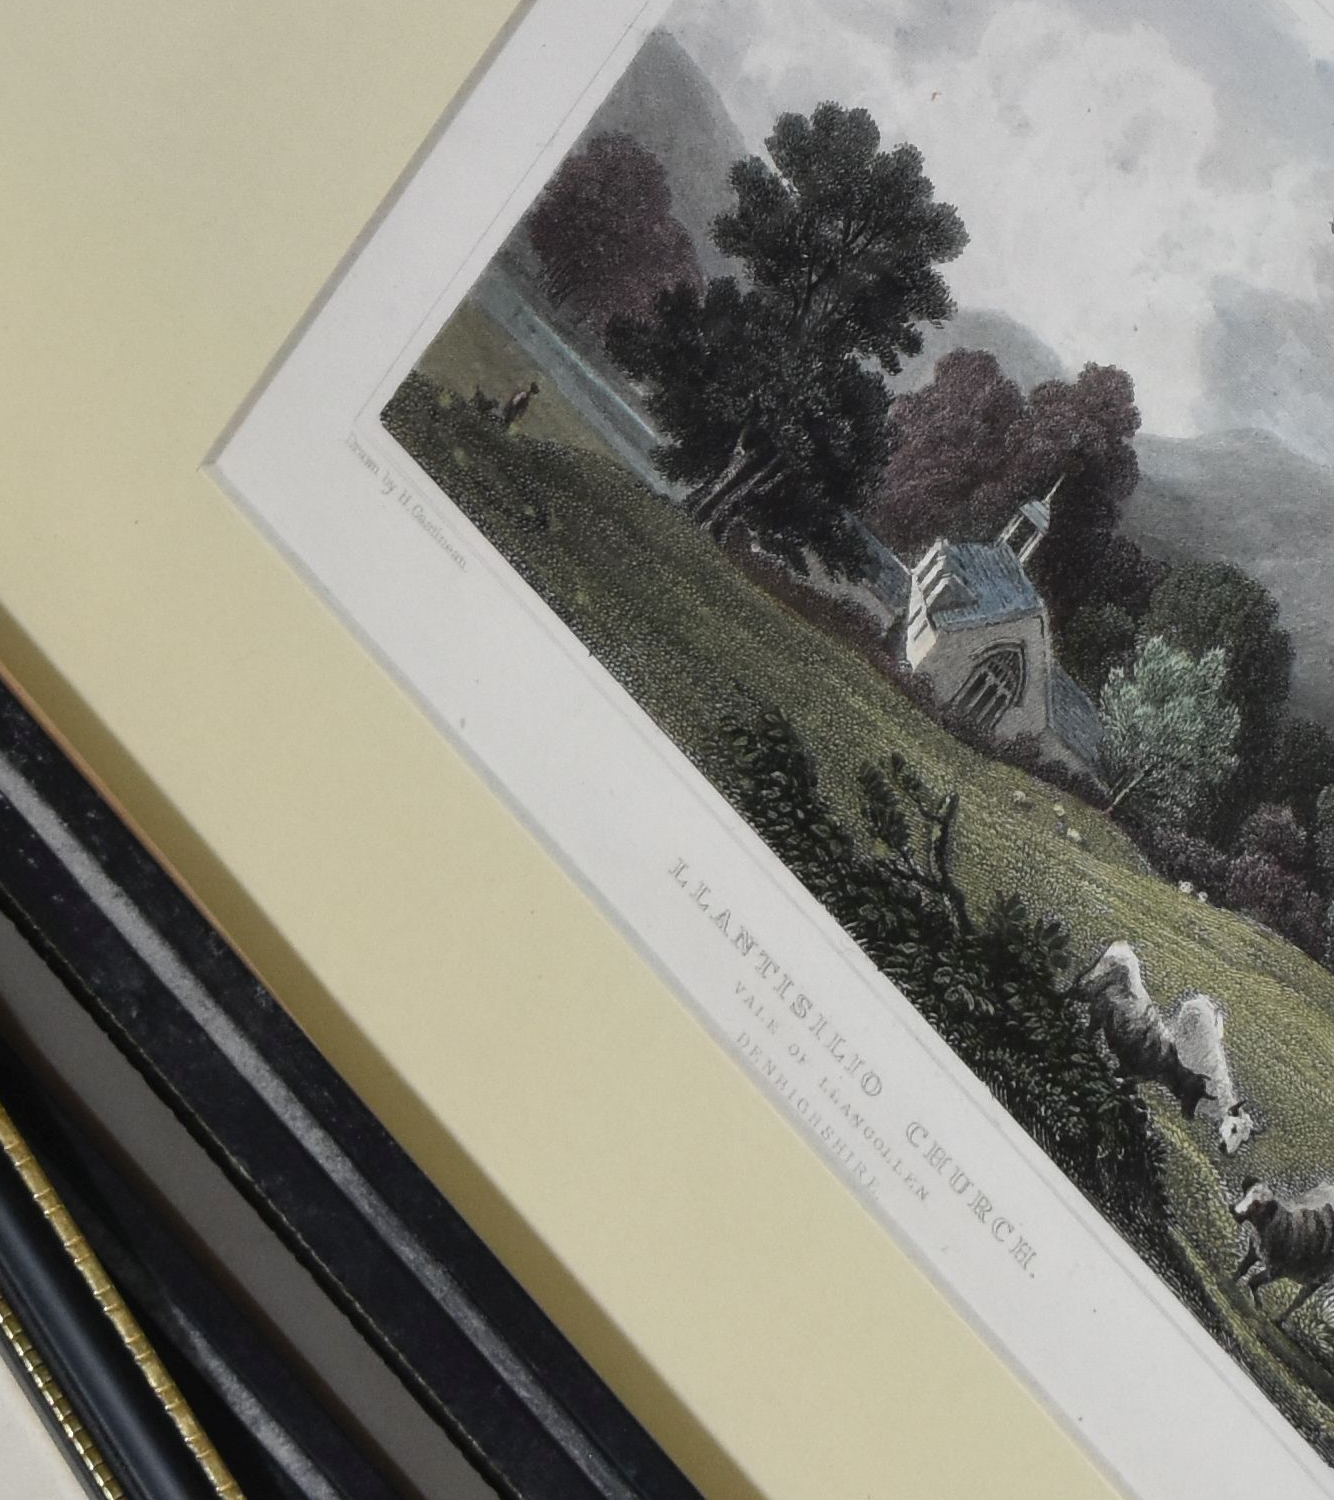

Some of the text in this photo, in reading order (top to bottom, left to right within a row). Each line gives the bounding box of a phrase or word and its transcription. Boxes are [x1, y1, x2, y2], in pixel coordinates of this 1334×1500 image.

[345, 434, 380, 475] Drawn
[380, 470, 398, 495] by
[667, 856, 1038, 1281] LLANTISILIO CHURCH.
[733, 981, 931, 1202] VALE OF LLANGOLLEN
